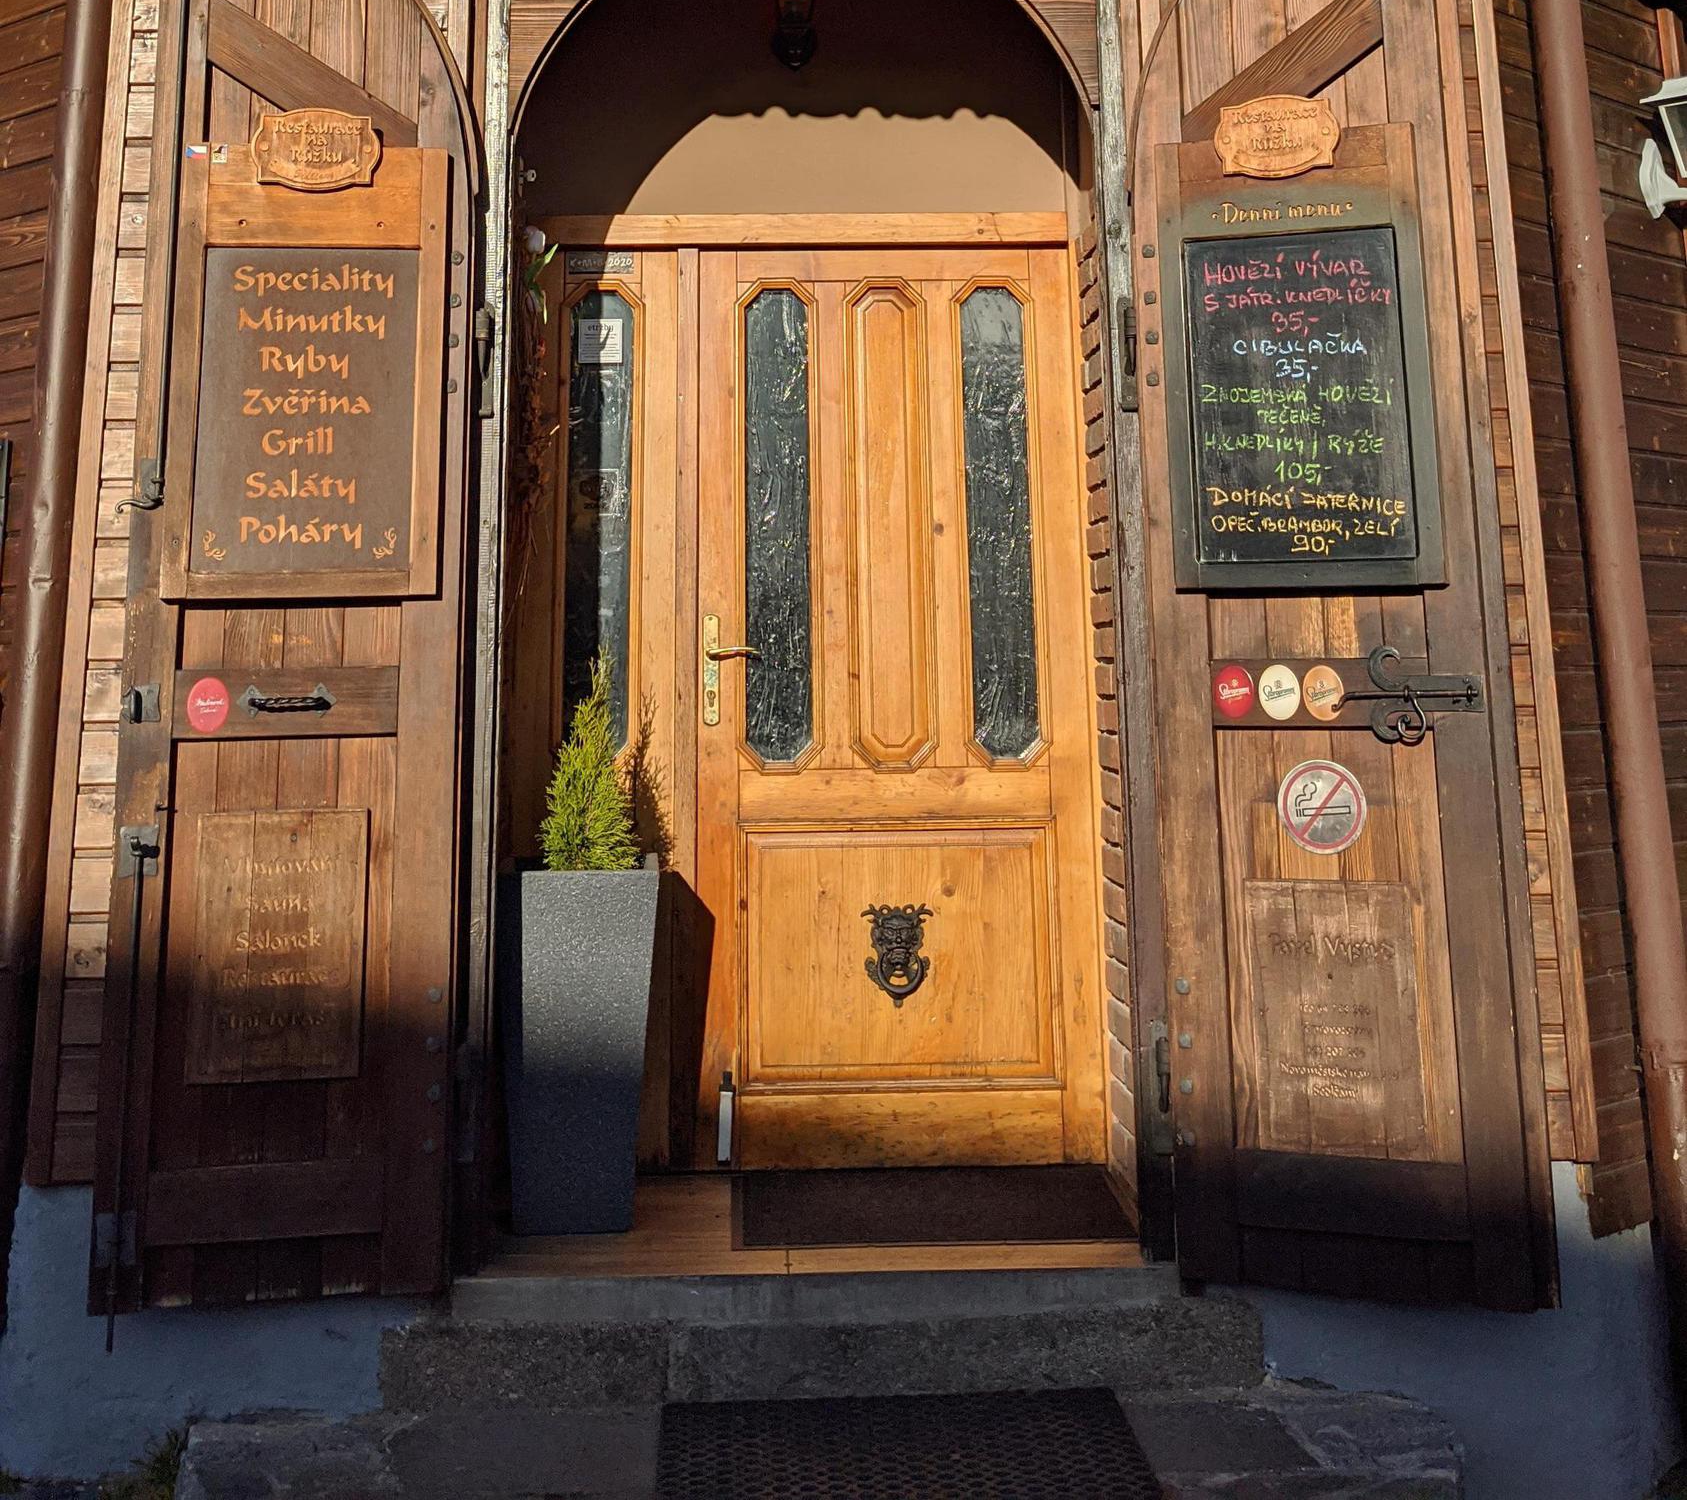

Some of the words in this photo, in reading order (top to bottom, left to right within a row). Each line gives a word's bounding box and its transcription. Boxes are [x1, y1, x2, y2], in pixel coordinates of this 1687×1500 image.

[273, 118, 363, 136] Restaurace
[1222, 201, 1283, 224] Denní
[1288, 203, 1343, 219] menu
[608, 257, 633, 268] 2020
[1204, 252, 1286, 287] HOVĚZÍ
[1295, 250, 1372, 279] VÝVAR
[232, 264, 396, 299] Speciality
[1204, 293, 1220, 312] S
[1285, 278, 1392, 306] KNEDLÍČKY
[237, 305, 387, 340] Minutky
[1271, 310, 1320, 338] 35,-
[1233, 332, 1368, 356] CIBULAČKA
[259, 345, 350, 380] Ryby
[242, 388, 372, 417] Zvěřina
[1318, 377, 1394, 406] HOVĚZÍ
[261, 427, 334, 457] Grill
[1327, 428, 1385, 456] RÝŽE
[245, 468, 357, 505] Saláty
[1274, 460, 1333, 486] 105,-
[1206, 485, 1295, 510] DOMÁCÍ
[238, 515, 363, 550] Poháry
[1353, 517, 1400, 538] ZELÍ
[1291, 534, 1336, 556] 90,-
